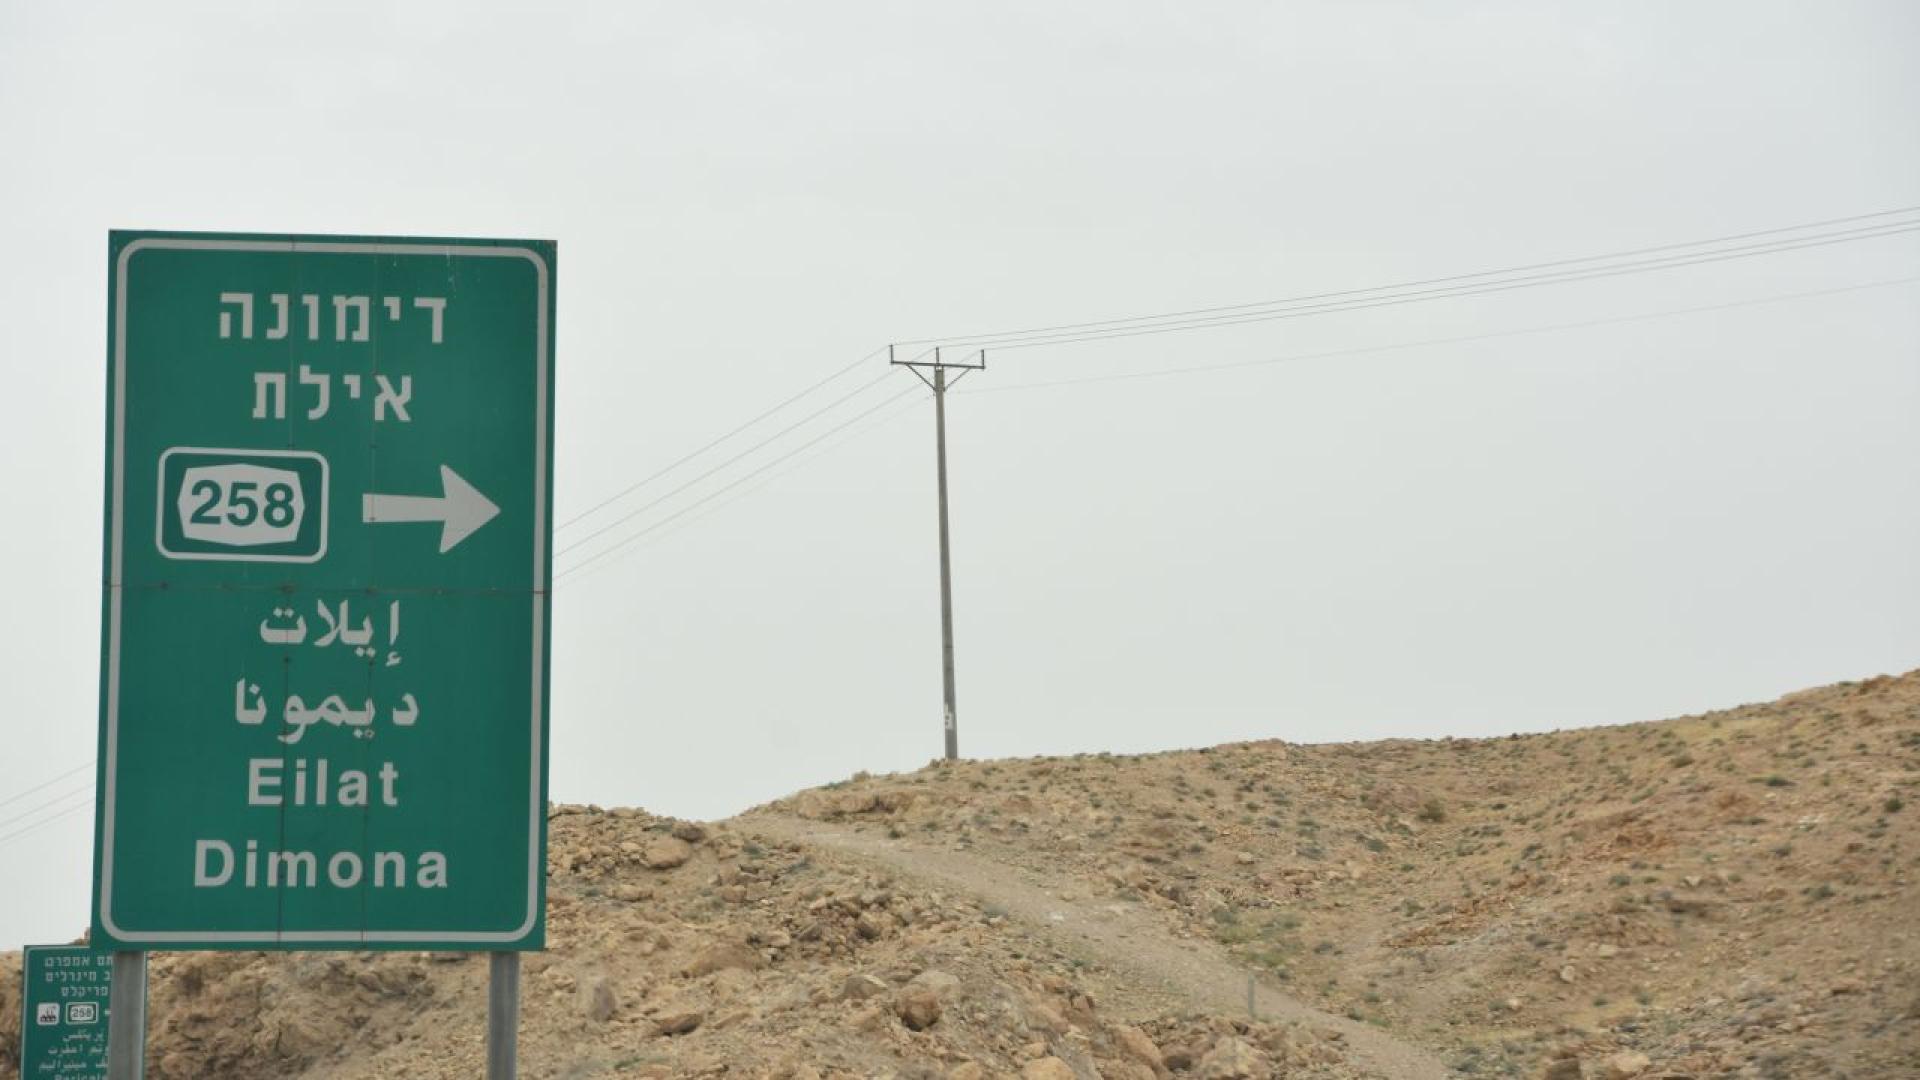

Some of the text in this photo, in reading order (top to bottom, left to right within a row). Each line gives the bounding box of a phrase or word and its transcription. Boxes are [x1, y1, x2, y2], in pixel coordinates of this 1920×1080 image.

[218, 292, 448, 344] דימונה
[252, 365, 413, 422] אילת
[189, 480, 296, 529] 258
[260, 599, 401, 667] إيلات
[235, 678, 419, 744] ديمونا
[248, 757, 399, 807] Eilat
[194, 839, 449, 889] Dimona
